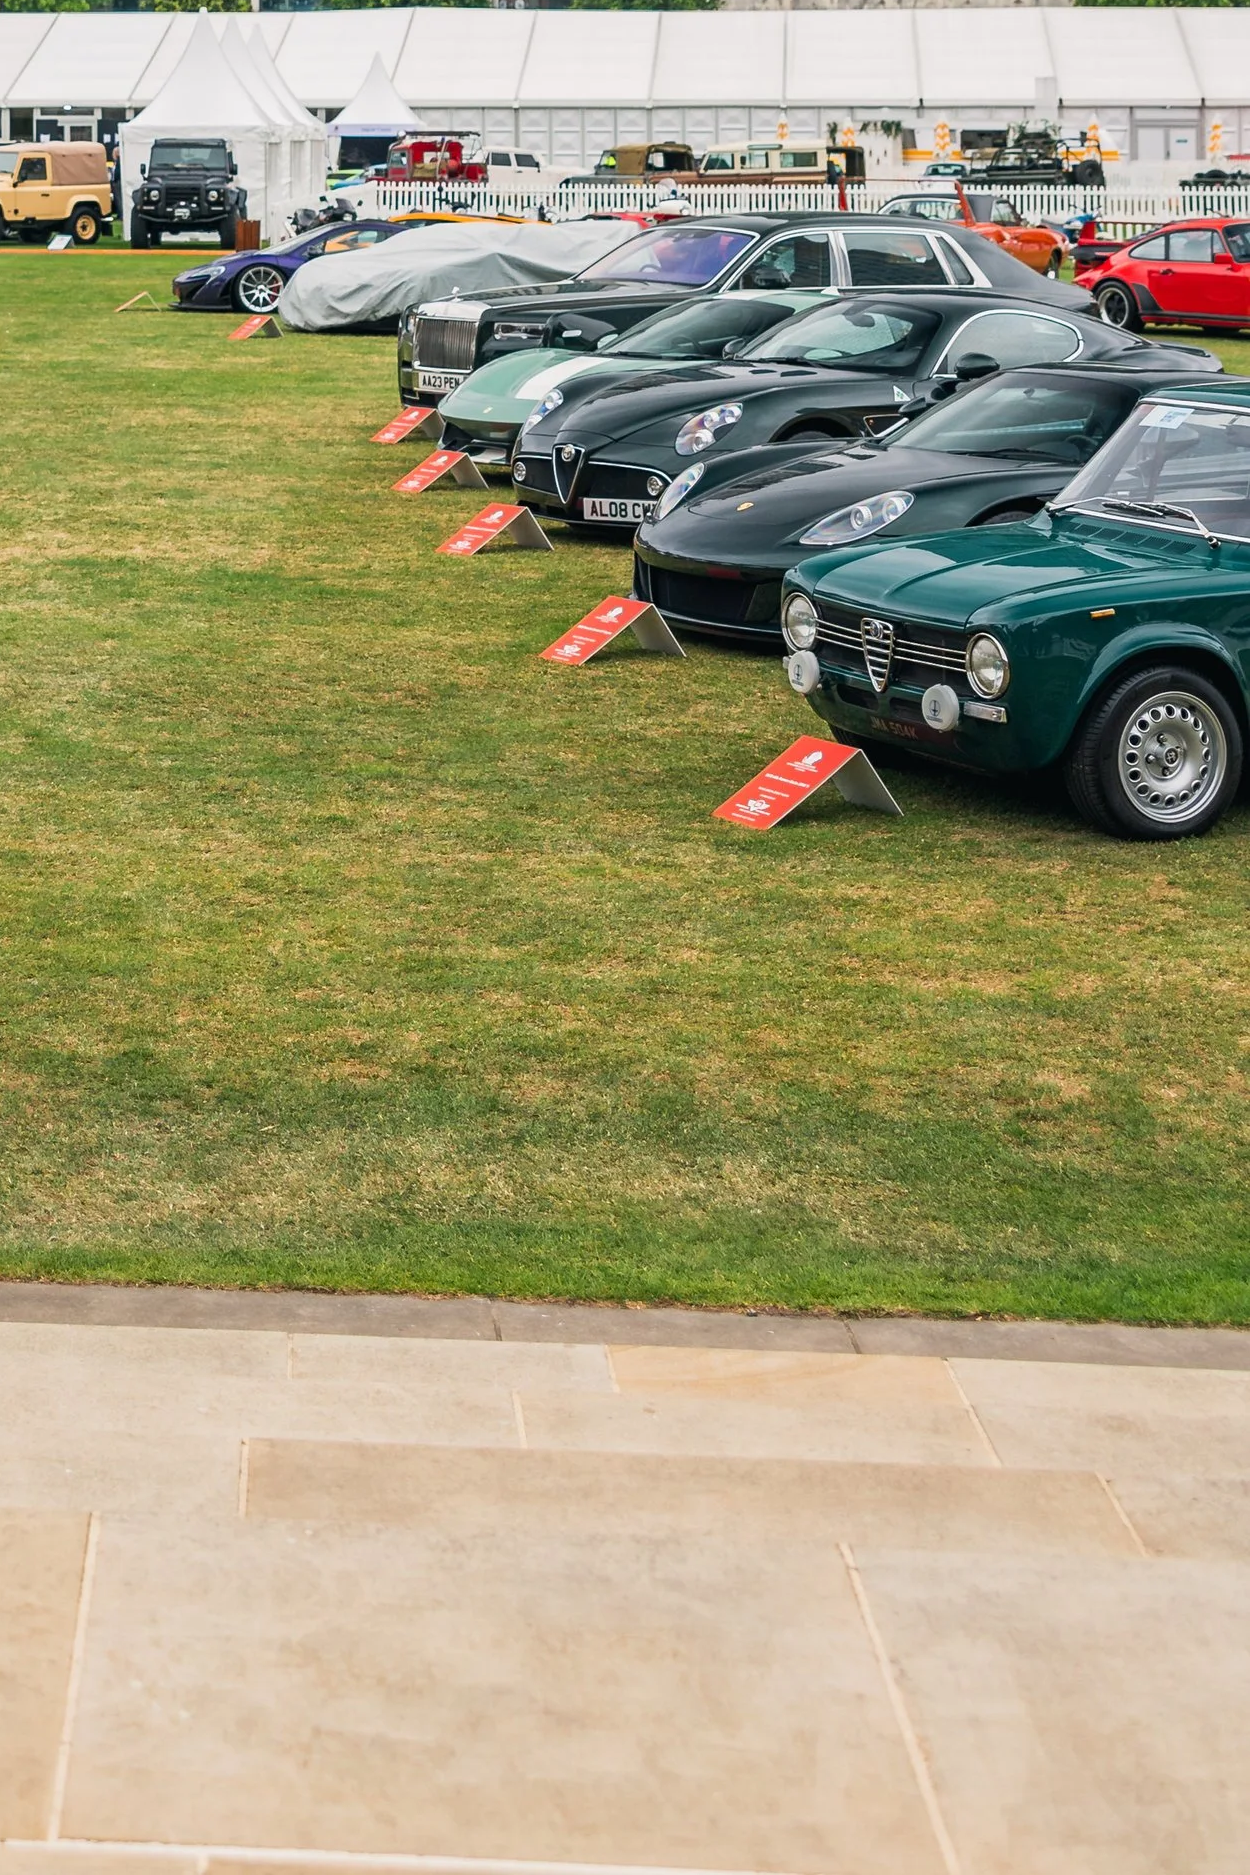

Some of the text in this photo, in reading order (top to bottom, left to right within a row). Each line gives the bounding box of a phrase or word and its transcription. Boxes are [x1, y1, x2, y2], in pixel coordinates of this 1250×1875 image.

[422, 375, 460, 389] AA23 PEN
[590, 500, 628, 518] AL08
